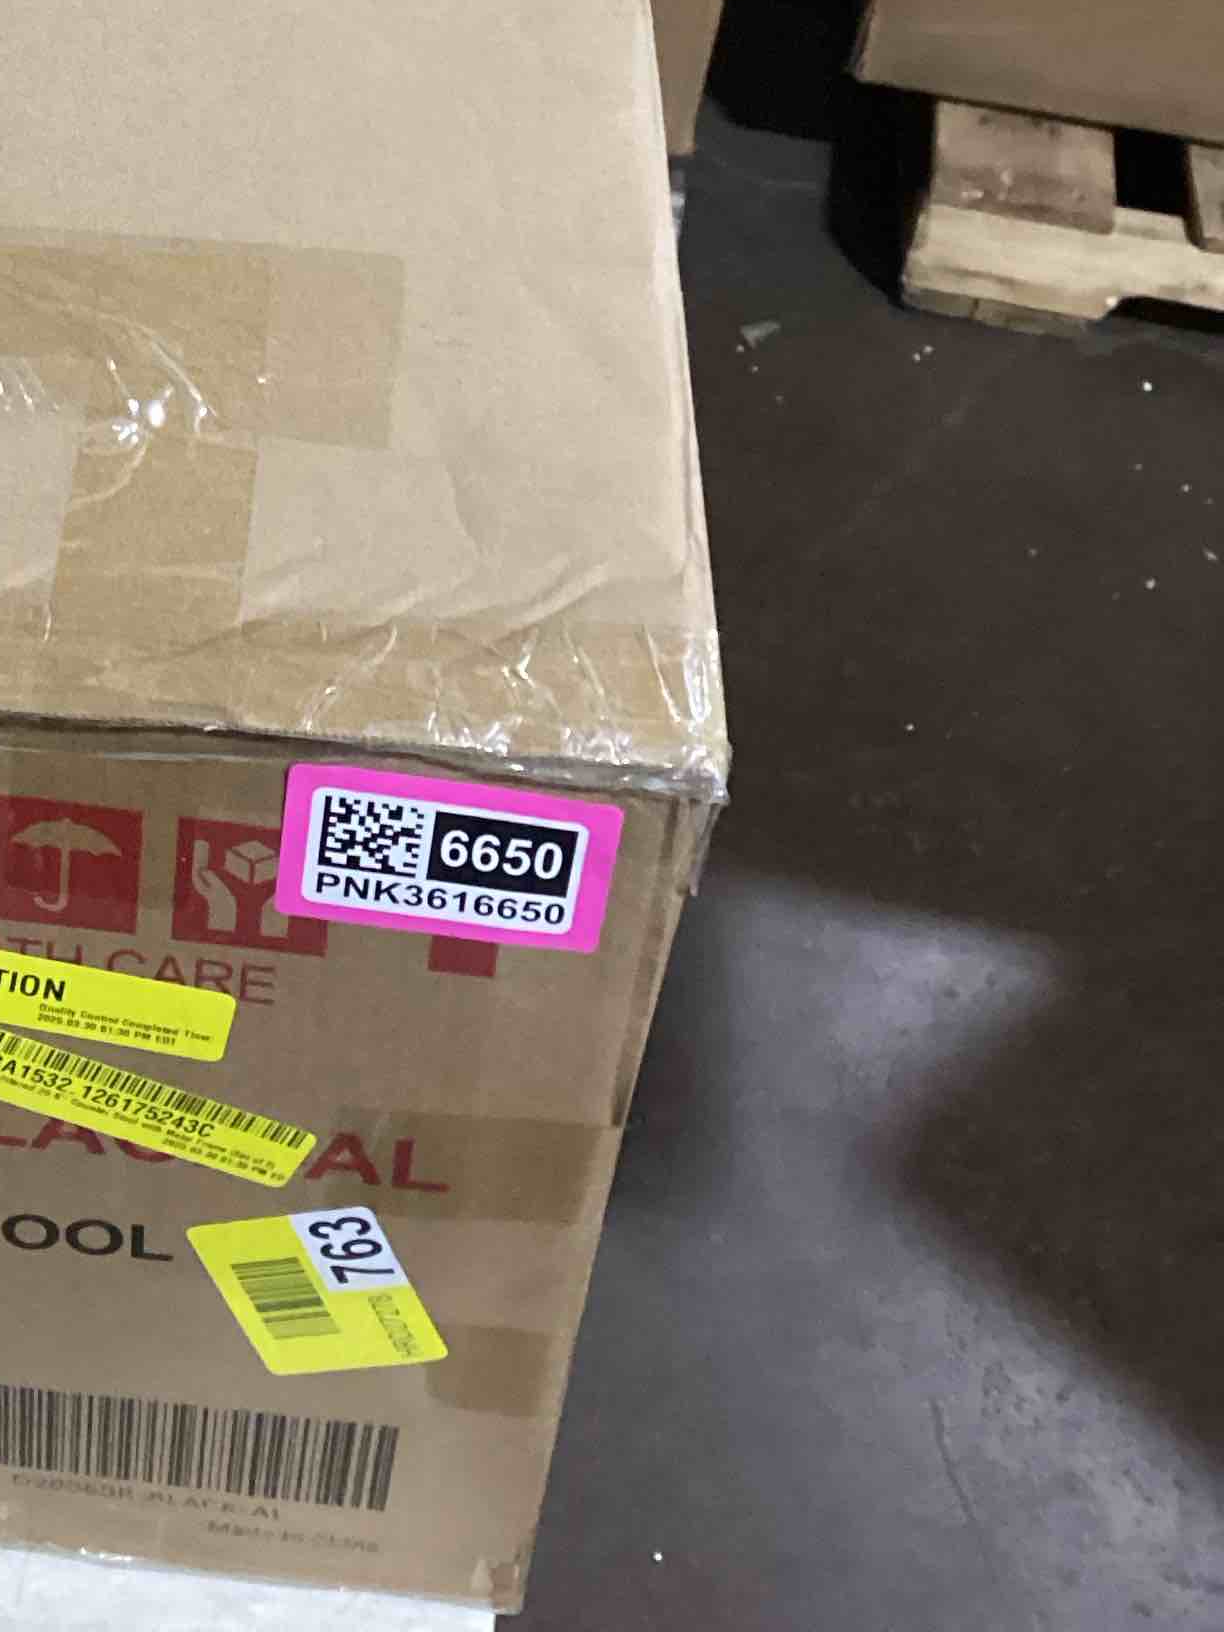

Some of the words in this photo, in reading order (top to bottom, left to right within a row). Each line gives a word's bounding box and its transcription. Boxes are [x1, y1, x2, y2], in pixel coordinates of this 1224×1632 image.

[439, 828, 564, 881] 6650
[316, 872, 566, 926] PNK3616650
[107, 948, 277, 1005] CARE
[306, 1215, 395, 1285] 763
